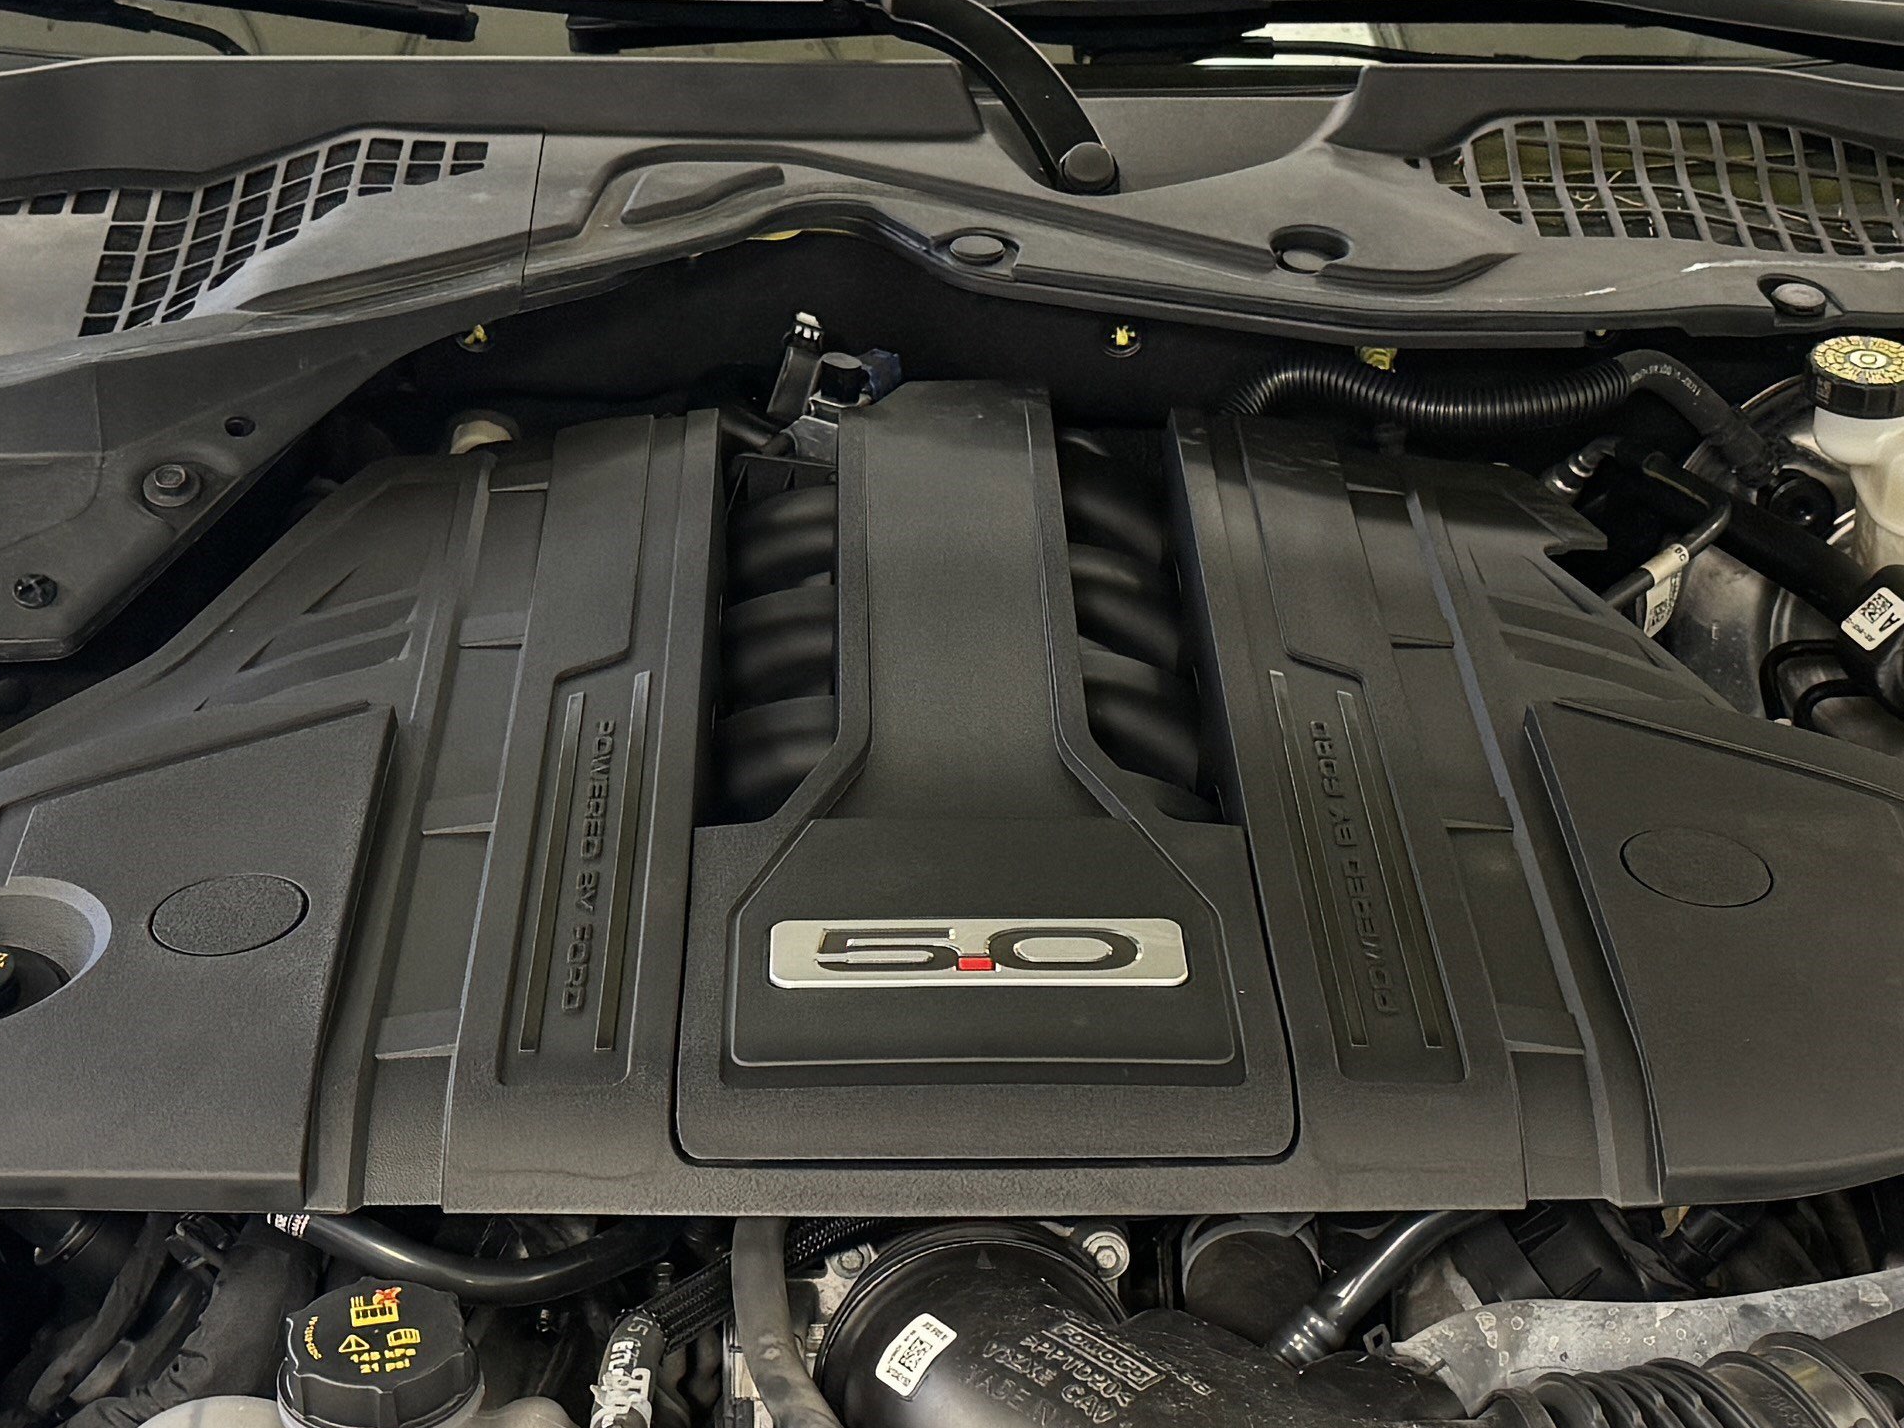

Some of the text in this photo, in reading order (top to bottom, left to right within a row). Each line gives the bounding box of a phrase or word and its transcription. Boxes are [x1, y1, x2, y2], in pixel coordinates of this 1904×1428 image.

[561, 721, 615, 1012] POWERED BY FORD
[815, 928, 1142, 972] 5.0
[1310, 721, 1396, 1013] POWERED BY FORD
[1061, 1384, 1117, 1424] CAV
